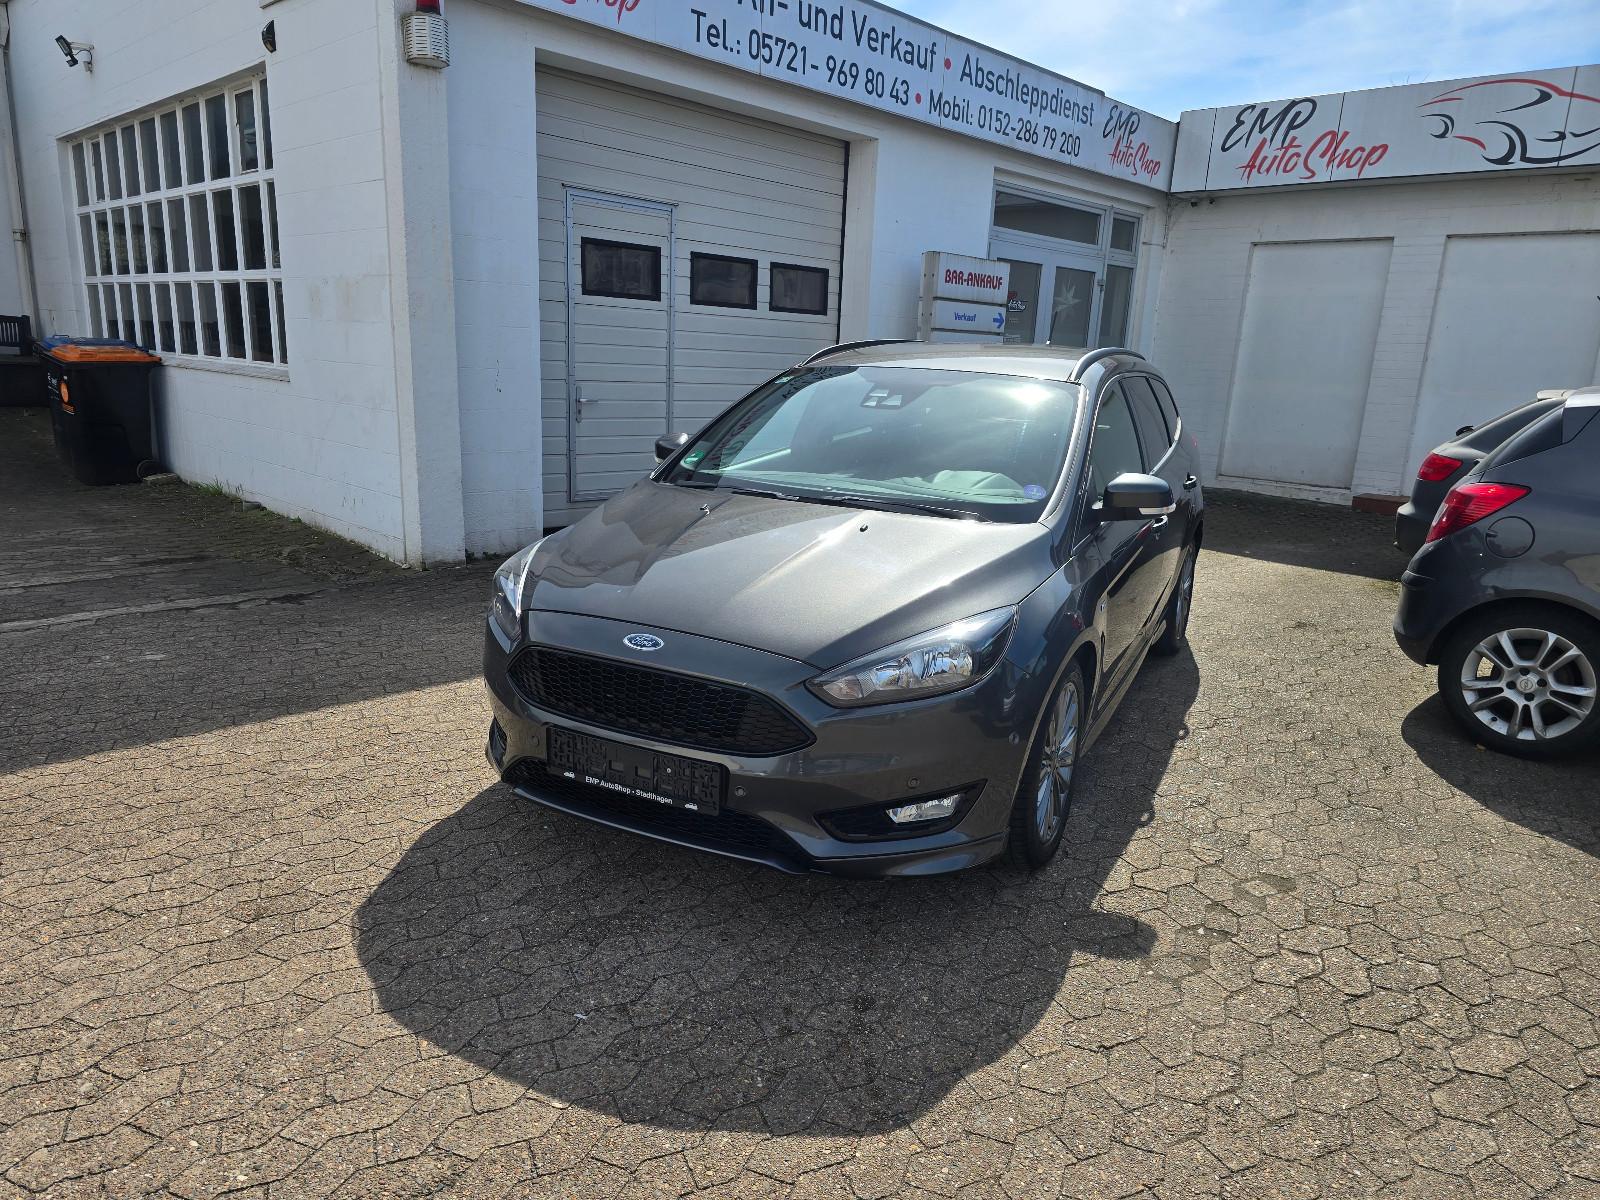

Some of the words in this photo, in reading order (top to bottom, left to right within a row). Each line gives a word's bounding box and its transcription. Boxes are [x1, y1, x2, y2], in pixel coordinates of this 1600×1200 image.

[690, 9, 741, 55] Tel.:
[826, 55, 860, 90] 969
[864, 67, 885, 98] 80
[889, 76, 910, 106] 43
[929, 89, 973, 126] Mobil:
[977, 105, 1039, 145] 0152-286
[1043, 127, 1058, 150] 79
[1059, 133, 1081, 158] 200
[799, 3, 844, 41] und
[851, 10, 937, 73] Verkauf
[959, 54, 1095, 127] Abschleppdienst
[1102, 104, 1141, 144] EMP
[1220, 97, 1317, 152] EMP
[944, 268, 1003, 290] BAR-ANKAUF
[954, 312, 977, 323] Verkauf
[585, 776, 599, 785] EMP
